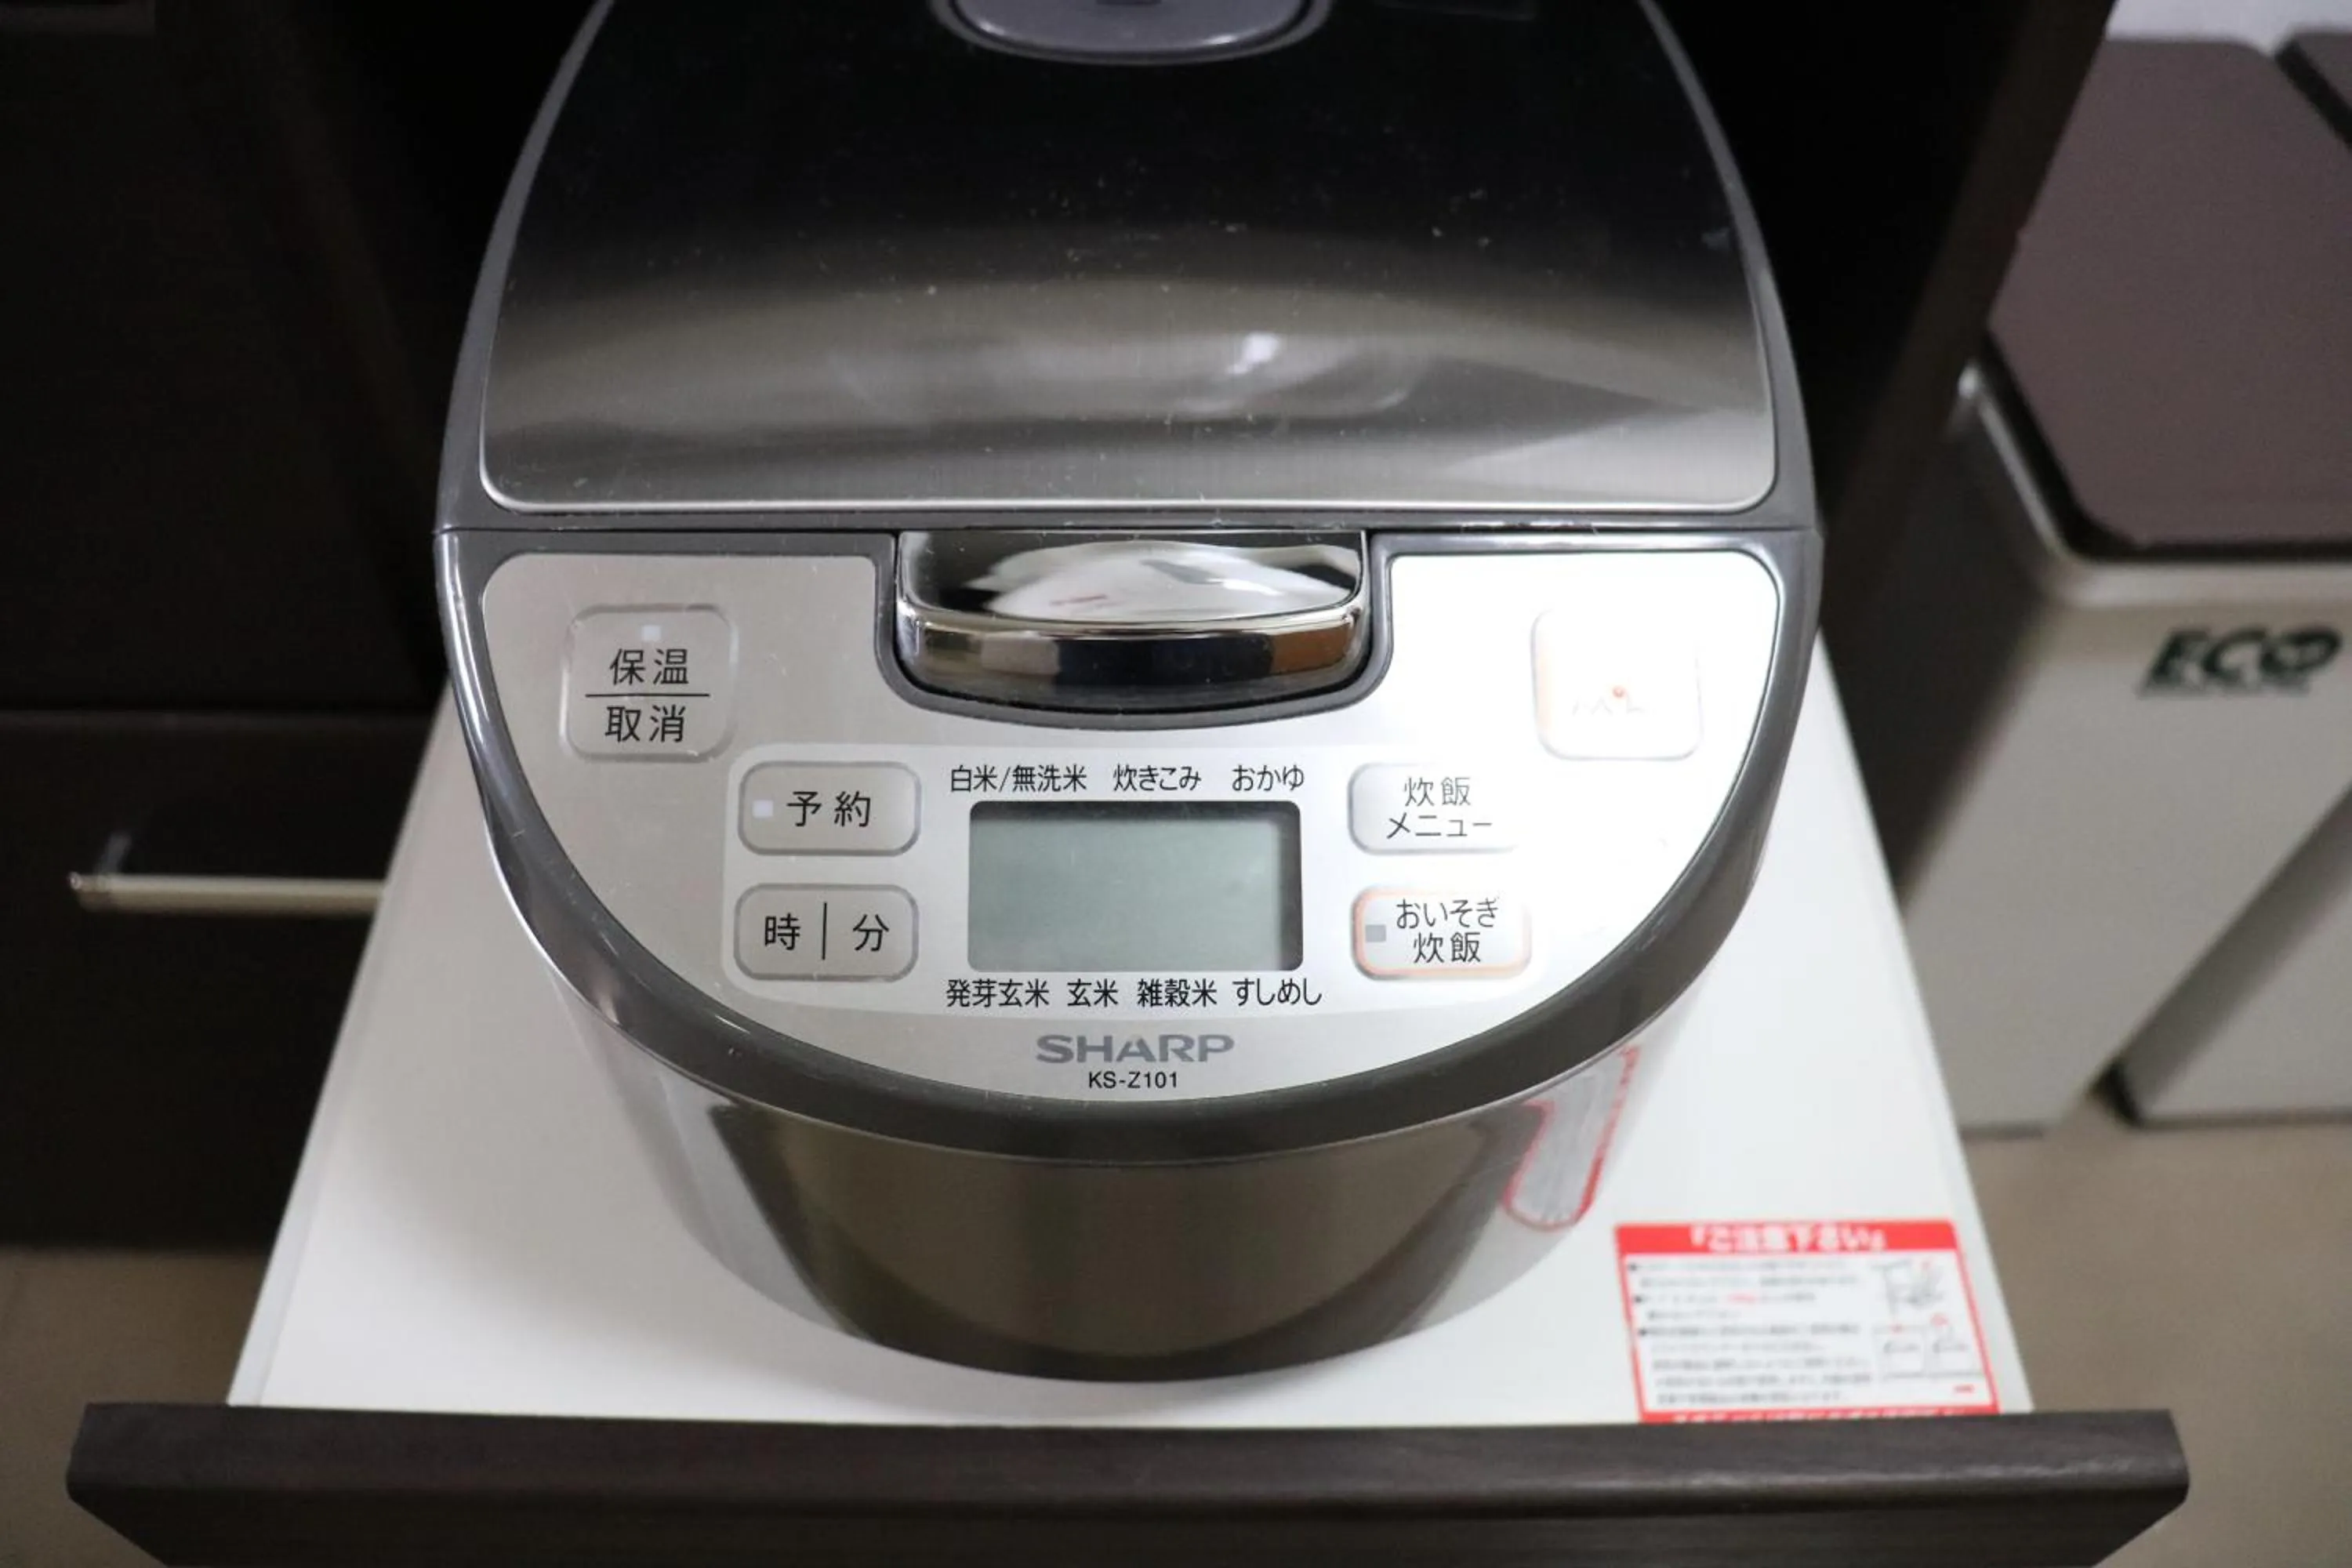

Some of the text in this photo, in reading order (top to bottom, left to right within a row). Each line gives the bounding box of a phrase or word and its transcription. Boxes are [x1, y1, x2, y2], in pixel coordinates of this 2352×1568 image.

[609, 648, 689, 686] 保温
[604, 705, 685, 743] 取消
[950, 764, 1305, 793] 白米/無洗米 炊きこみ おかゆ
[1403, 776, 1472, 808] 炊飯
[786, 790, 872, 827] 予約
[1386, 812, 1494, 839] メニュー
[1396, 896, 1498, 930] おいそぎ
[1413, 932, 1481, 964] 炊飯
[946, 977, 1323, 1007] 発芽玄米 玄米 雑穀米 すしめし
[1035, 1033, 1235, 1065] SHARP
[1088, 1071, 1178, 1089] KS-Z101
